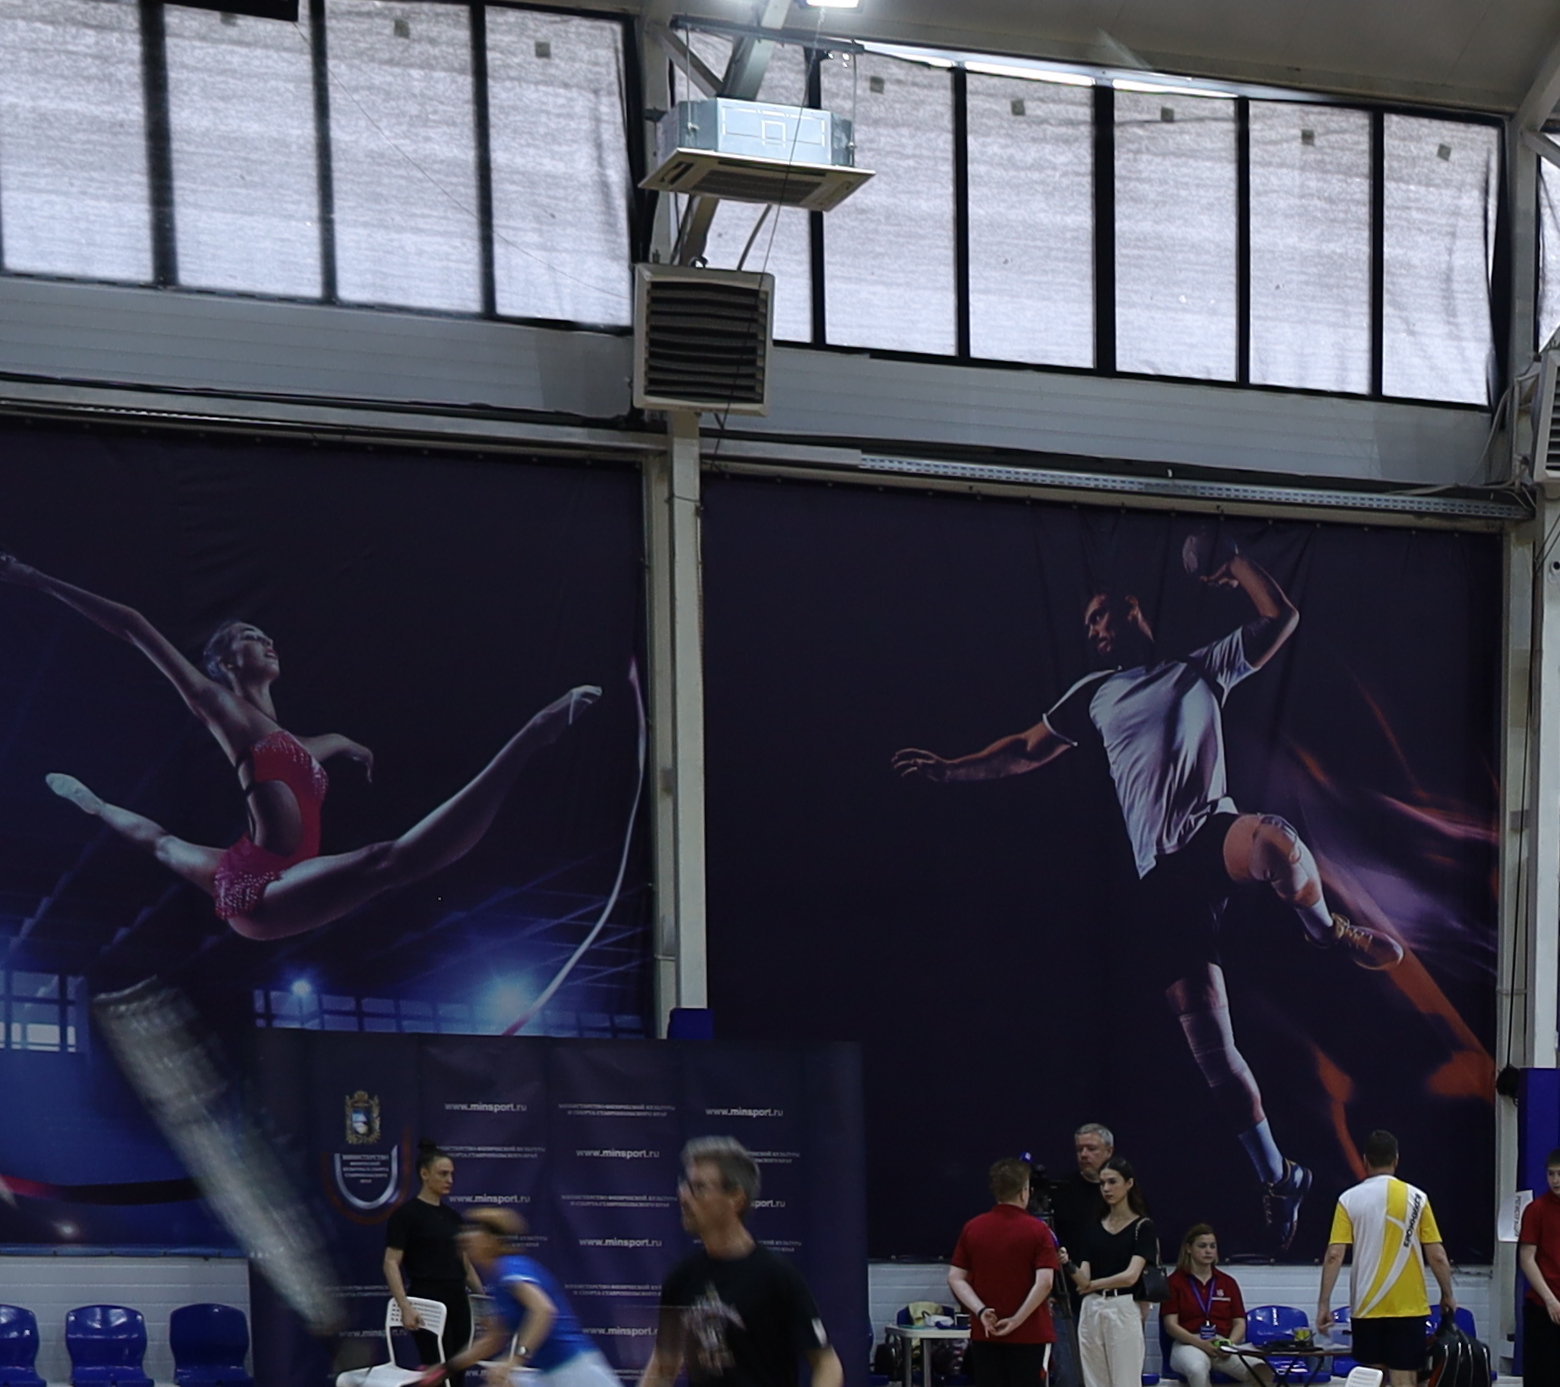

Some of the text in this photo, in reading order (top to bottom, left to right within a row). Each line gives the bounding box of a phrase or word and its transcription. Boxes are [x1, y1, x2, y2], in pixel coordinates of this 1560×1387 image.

[444, 1101, 527, 1113] www.minsport.ru
[705, 1106, 784, 1118] www.minsport.ru
[576, 1148, 660, 1160] www.minsport.ru
[448, 1193, 531, 1205] www.minsport.ru
[578, 1237, 662, 1248] www.minsport.ru
[581, 1325, 658, 1337] www.minsport.r
